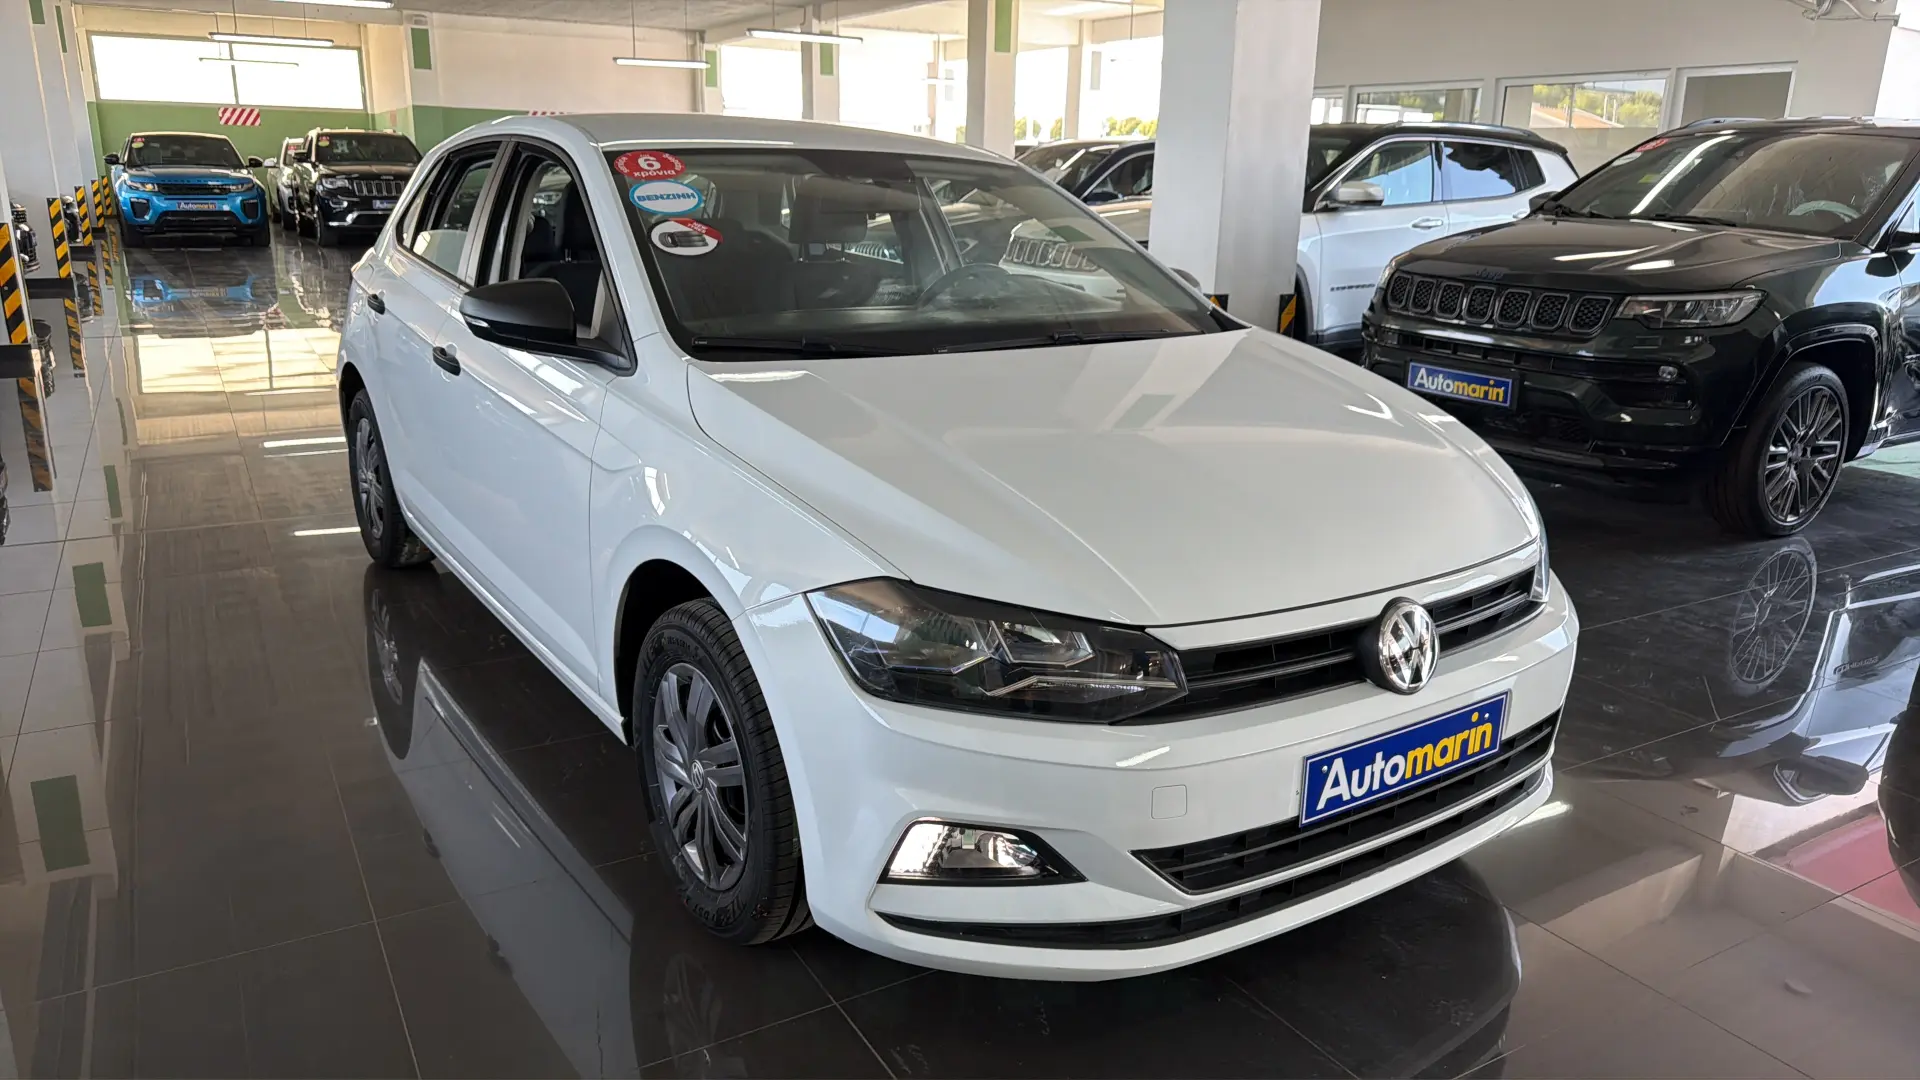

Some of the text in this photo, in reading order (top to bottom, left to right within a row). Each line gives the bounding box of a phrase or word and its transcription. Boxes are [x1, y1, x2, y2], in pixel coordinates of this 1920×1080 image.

[638, 156, 661, 170] 6
[1413, 367, 1505, 402] Automarin
[1316, 712, 1493, 811] Automarin
